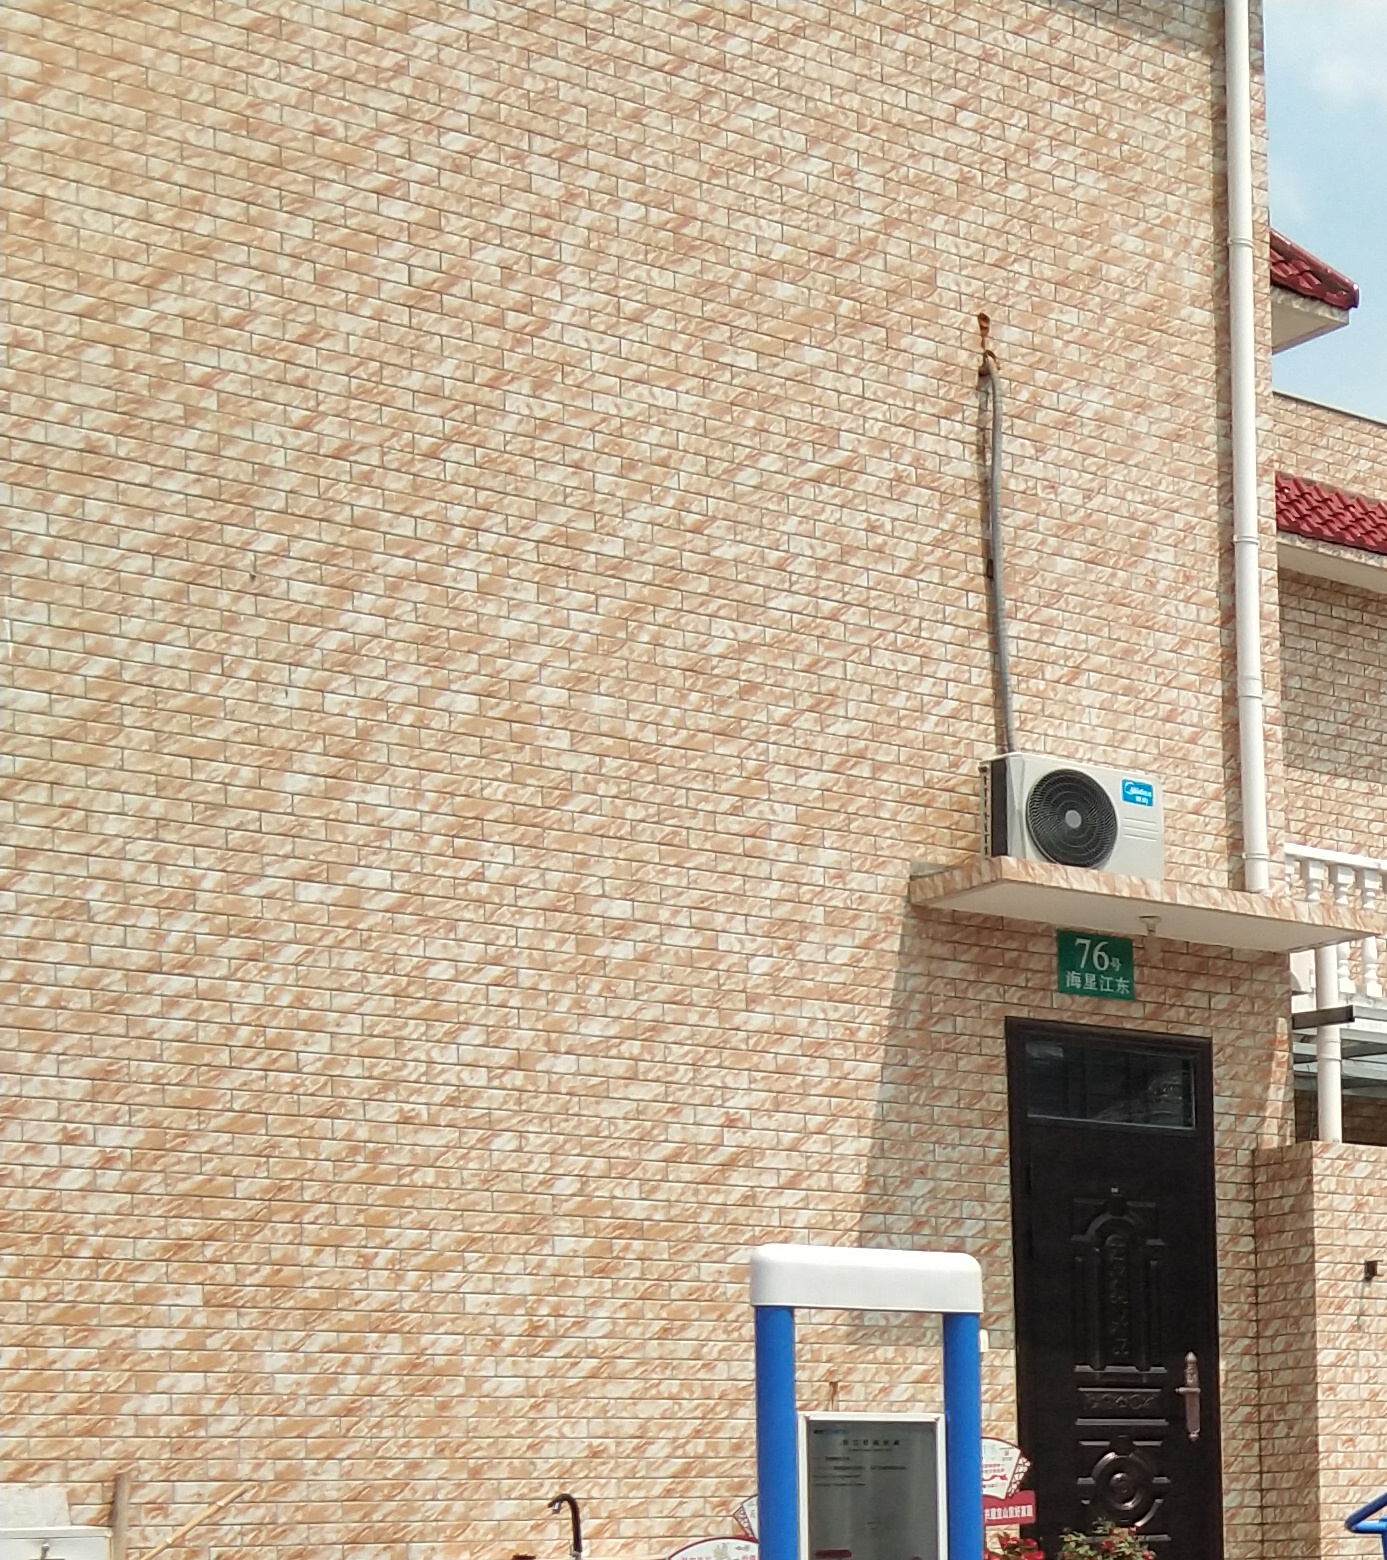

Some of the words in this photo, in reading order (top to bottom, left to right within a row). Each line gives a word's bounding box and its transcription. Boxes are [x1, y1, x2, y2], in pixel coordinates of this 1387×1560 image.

[1074, 937, 1122, 972] 76号
[1066, 970, 1130, 995] 海星江东
